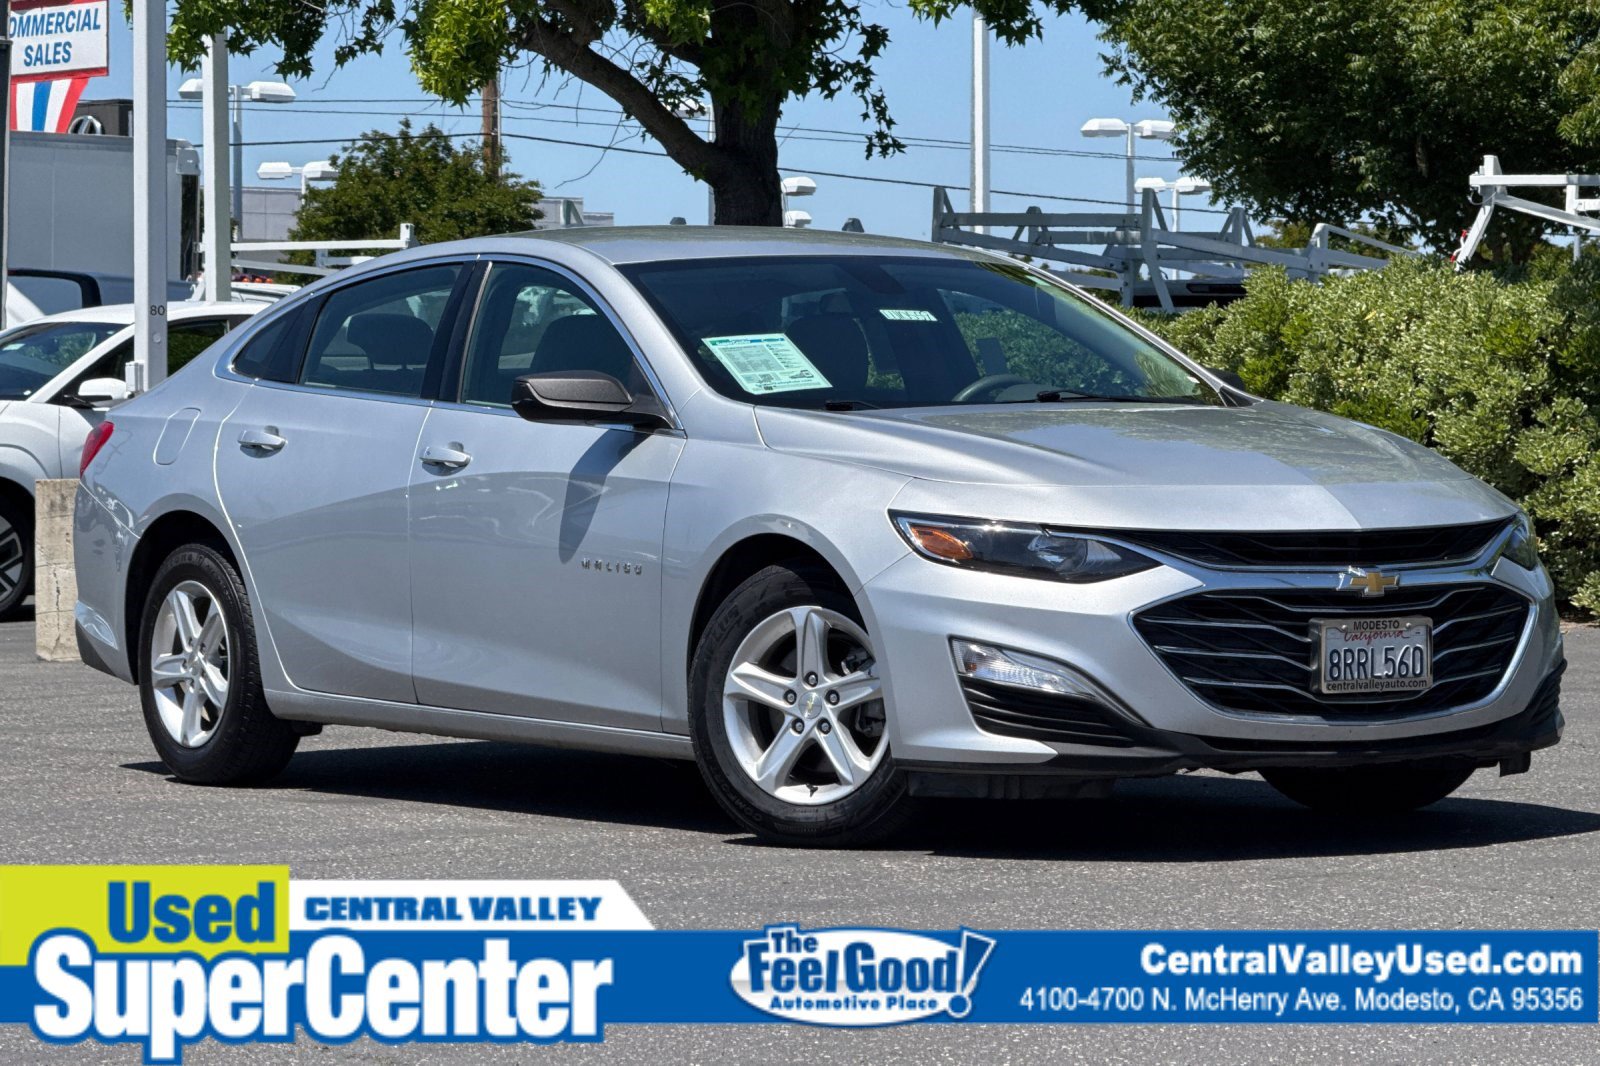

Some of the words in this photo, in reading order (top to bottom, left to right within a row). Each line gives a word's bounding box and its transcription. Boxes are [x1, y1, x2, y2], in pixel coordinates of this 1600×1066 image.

[9, 8, 101, 38] OMMERCIAL
[24, 41, 72, 67] SALES
[150, 304, 165, 316] 80
[1353, 620, 1400, 630] MODESTO
[1343, 629, 1411, 645] California
[1329, 644, 1424, 681] 8RRL560
[1327, 679, 1427, 691] centralvalleyauto.com
